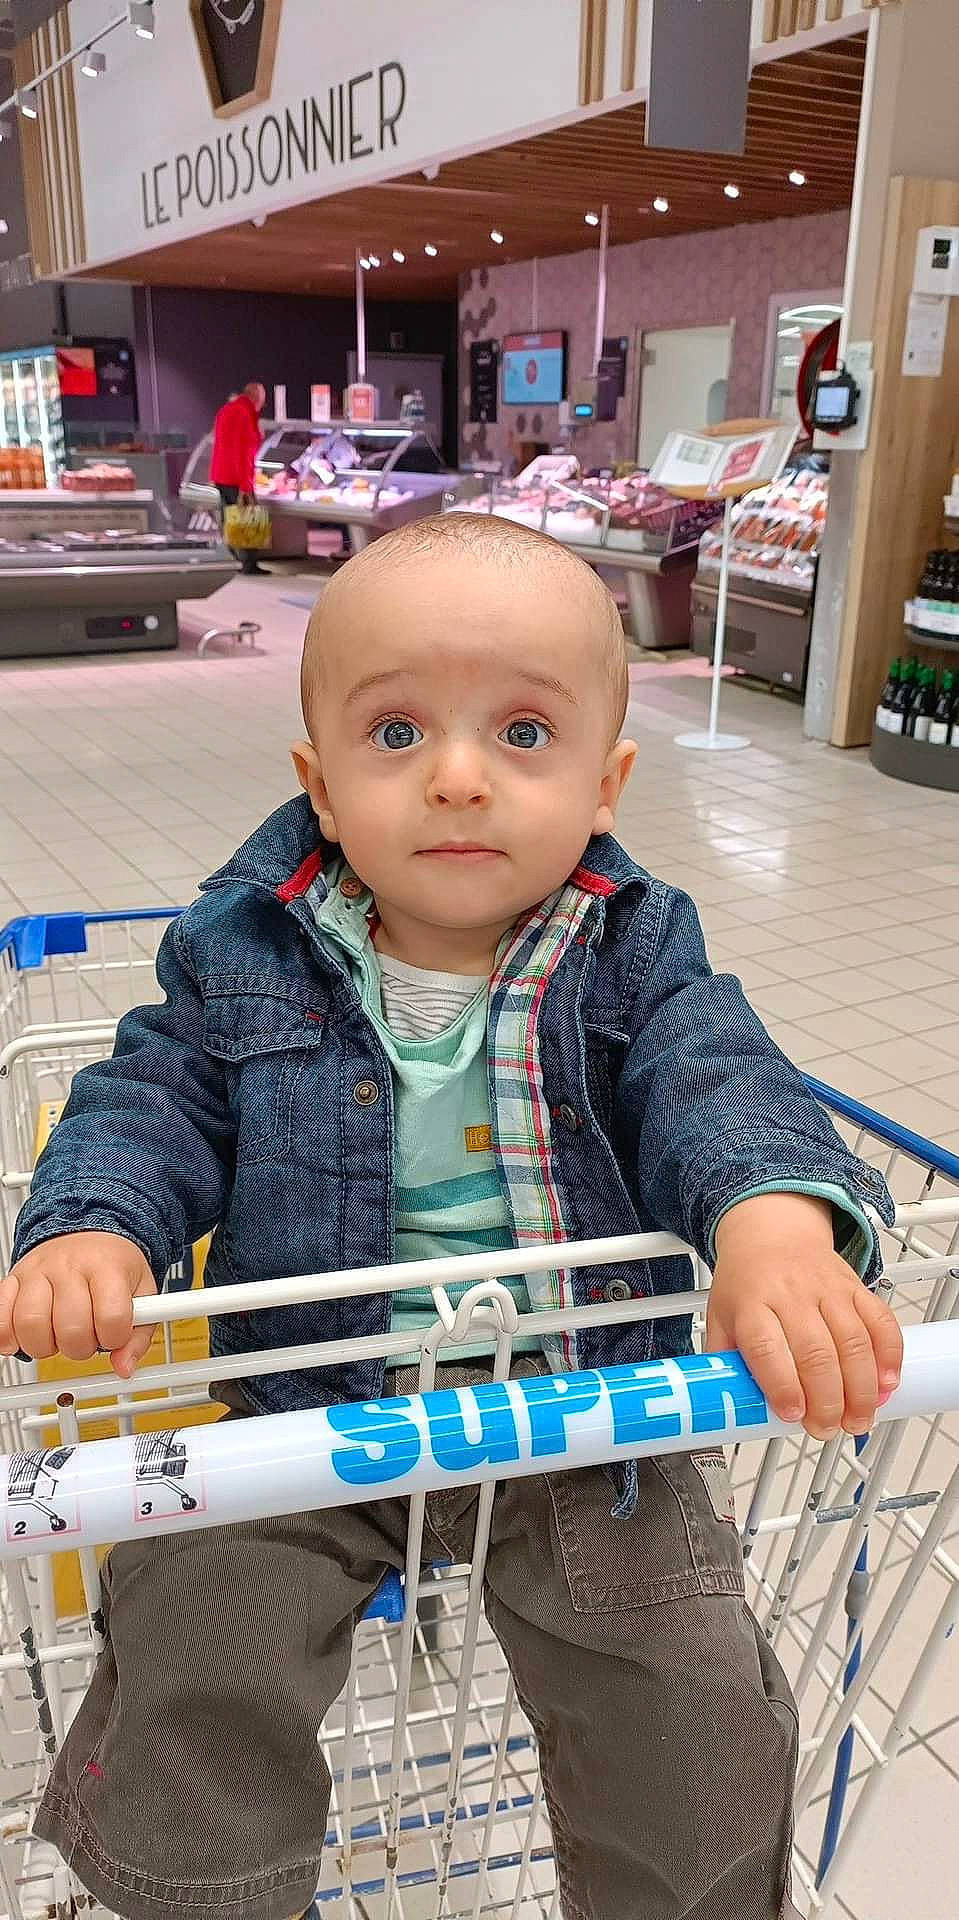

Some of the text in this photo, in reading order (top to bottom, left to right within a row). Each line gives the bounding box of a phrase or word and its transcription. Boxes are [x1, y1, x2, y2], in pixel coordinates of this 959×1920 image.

[142, 61, 406, 229] LE POISSONNIER
[326, 1349, 768, 1485] SUPER
[13, 1520, 27, 1536] 2
[140, 1501, 153, 1516] 3
